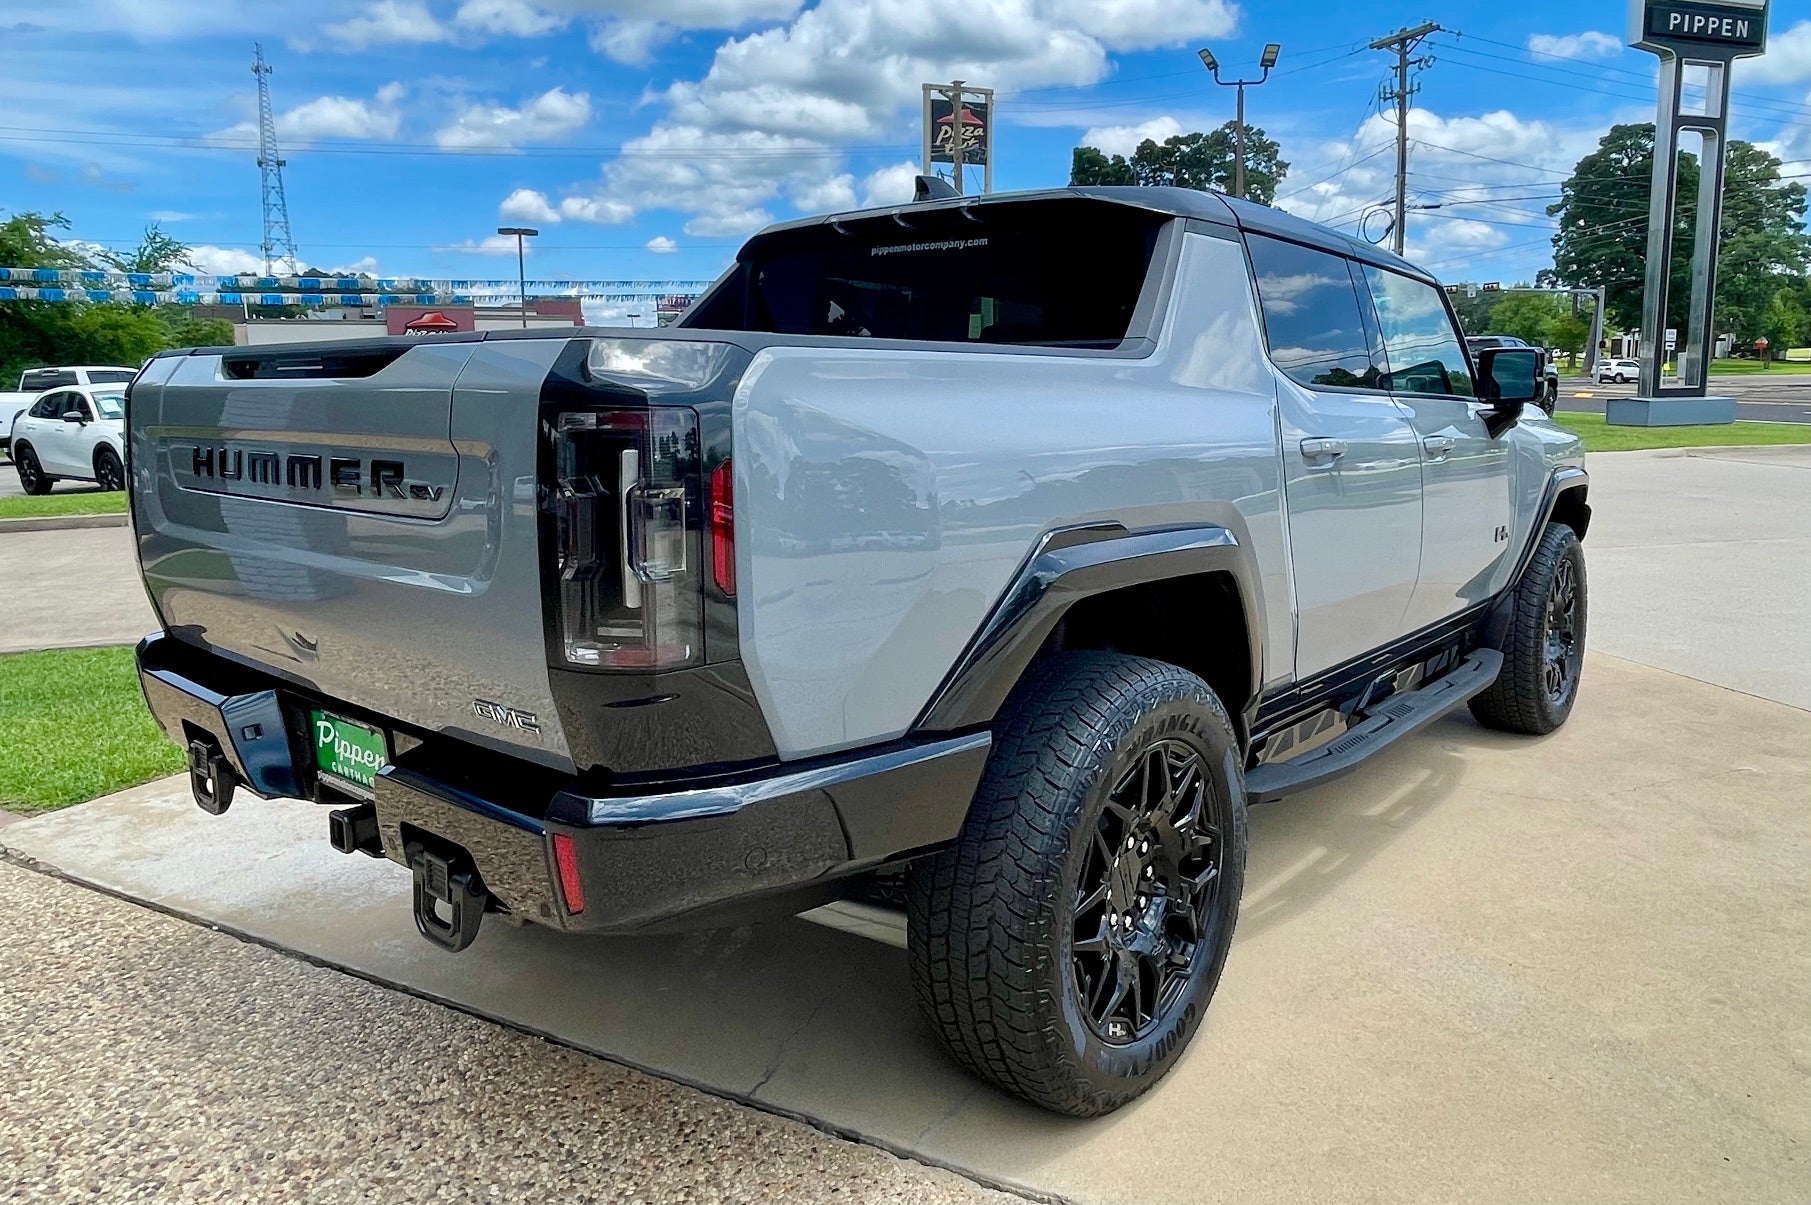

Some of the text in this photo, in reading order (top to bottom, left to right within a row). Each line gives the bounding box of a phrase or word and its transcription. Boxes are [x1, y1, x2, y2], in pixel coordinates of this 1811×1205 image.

[1669, 12, 1749, 38] PIPPEN
[871, 238, 989, 256] pippenmotorcompany.com
[193, 446, 408, 500] HUMMER
[472, 698, 542, 735] GMC
[316, 720, 385, 770] Pippen
[331, 761, 375, 789] CARTHAG
